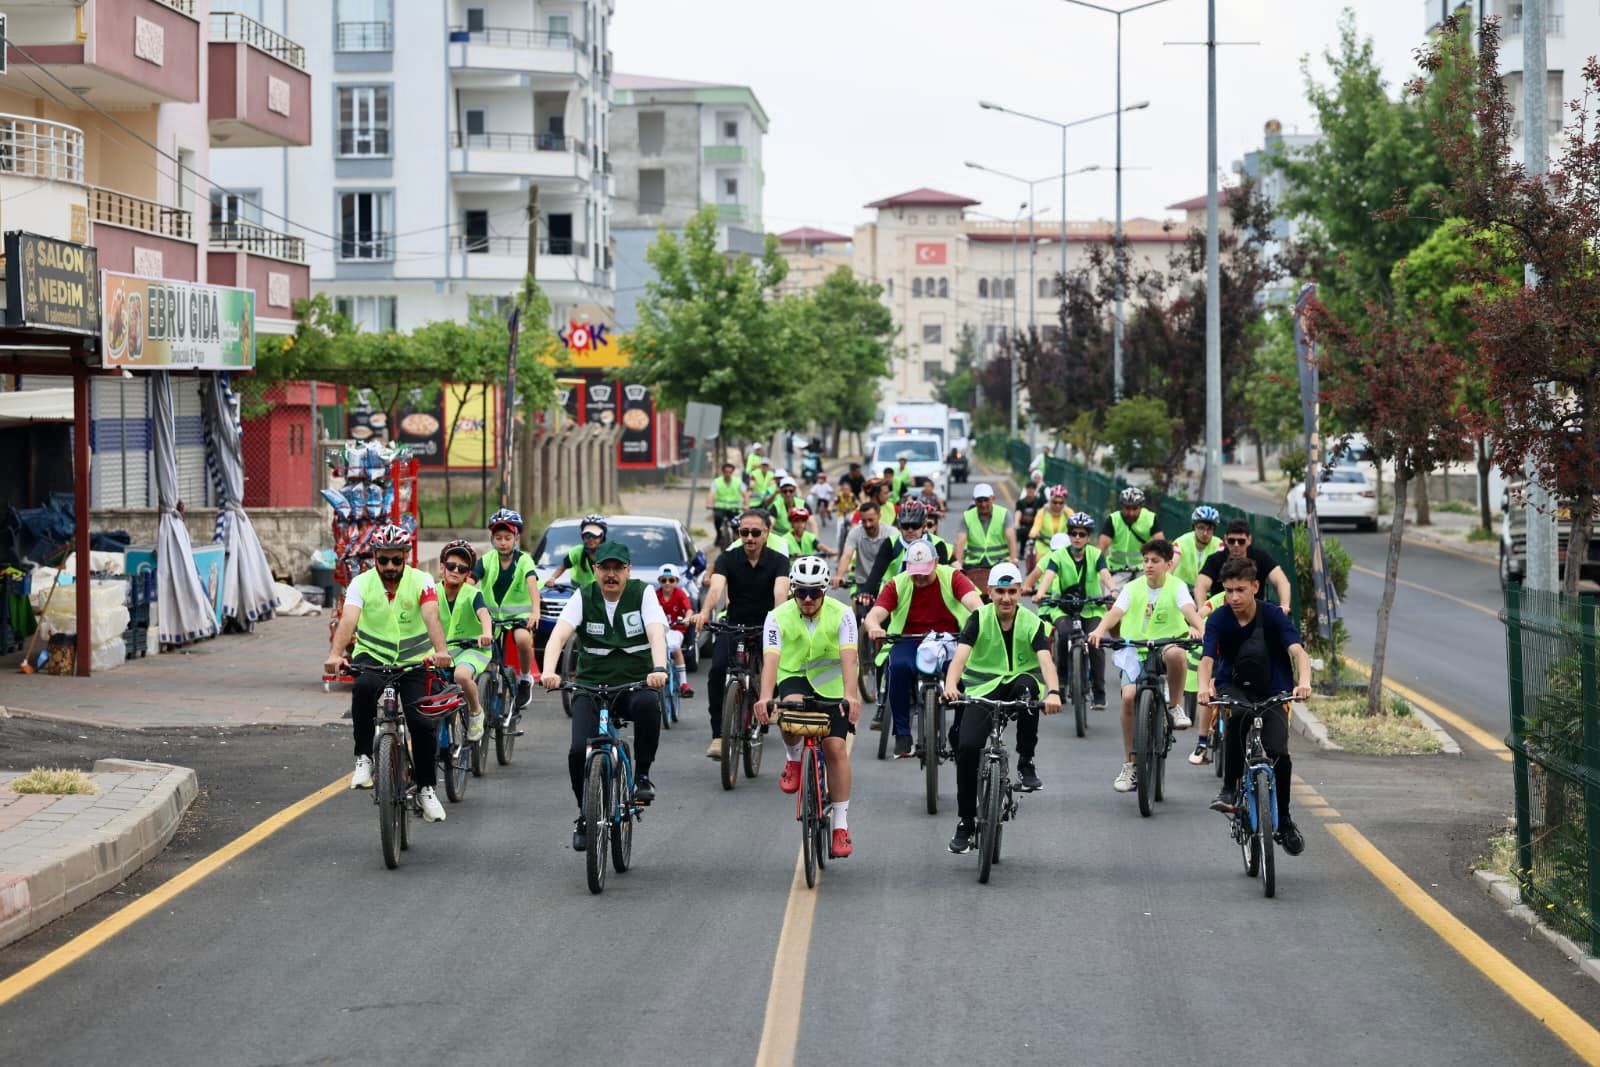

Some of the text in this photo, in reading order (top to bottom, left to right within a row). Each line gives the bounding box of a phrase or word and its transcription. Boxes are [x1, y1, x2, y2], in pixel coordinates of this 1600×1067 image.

[37, 240, 84, 273] SALON
[147, 284, 186, 342] EBRU
[189, 288, 220, 343] GIDA
[768, 629, 777, 646] VISA
